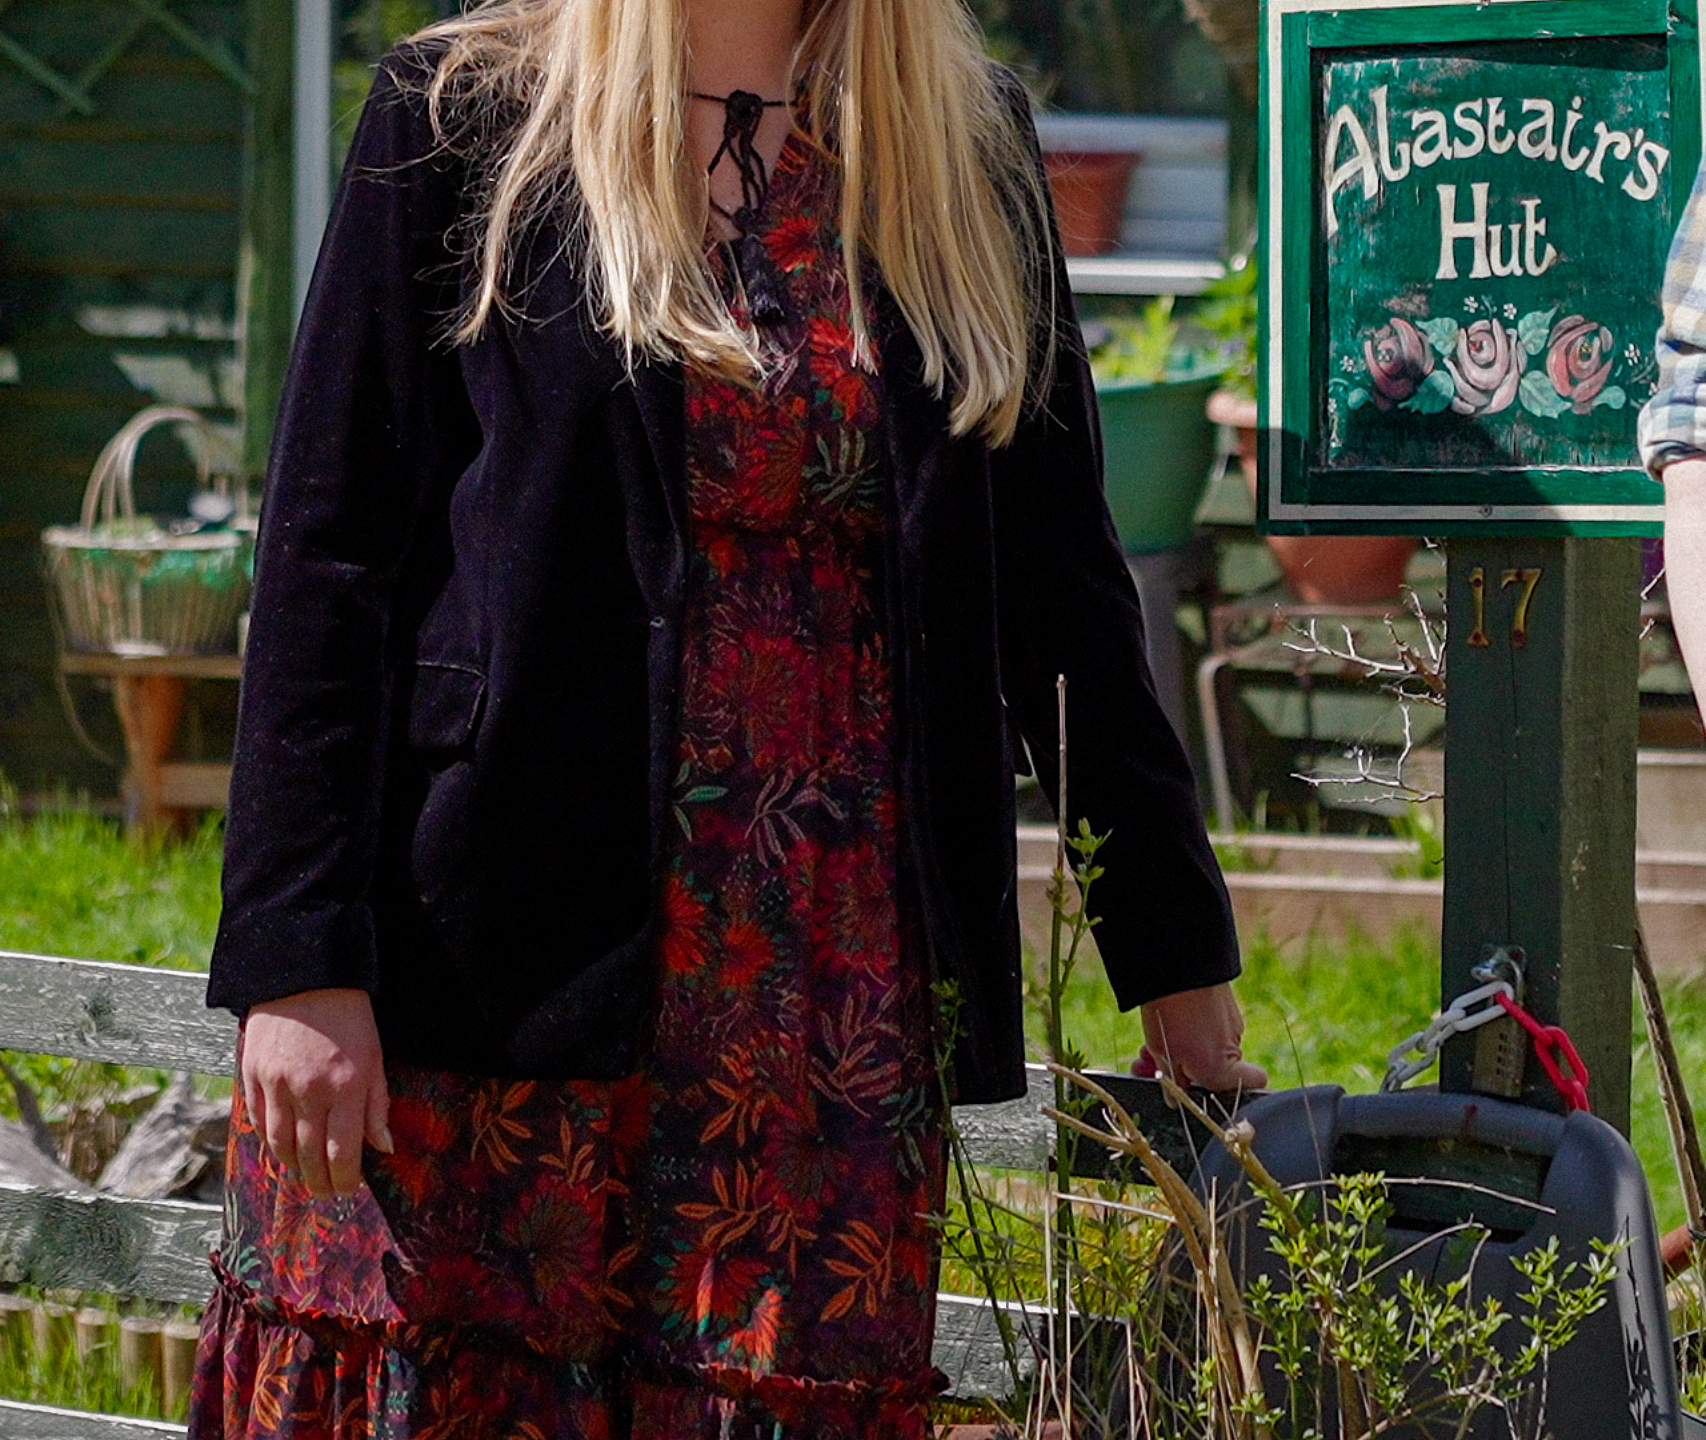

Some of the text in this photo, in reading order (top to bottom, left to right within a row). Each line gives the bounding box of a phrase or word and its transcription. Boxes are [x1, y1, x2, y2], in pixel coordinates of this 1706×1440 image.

[1324, 84, 1670, 238] Alastair's
[1435, 182, 1558, 280] Hut
[1467, 567, 1542, 647] 17
